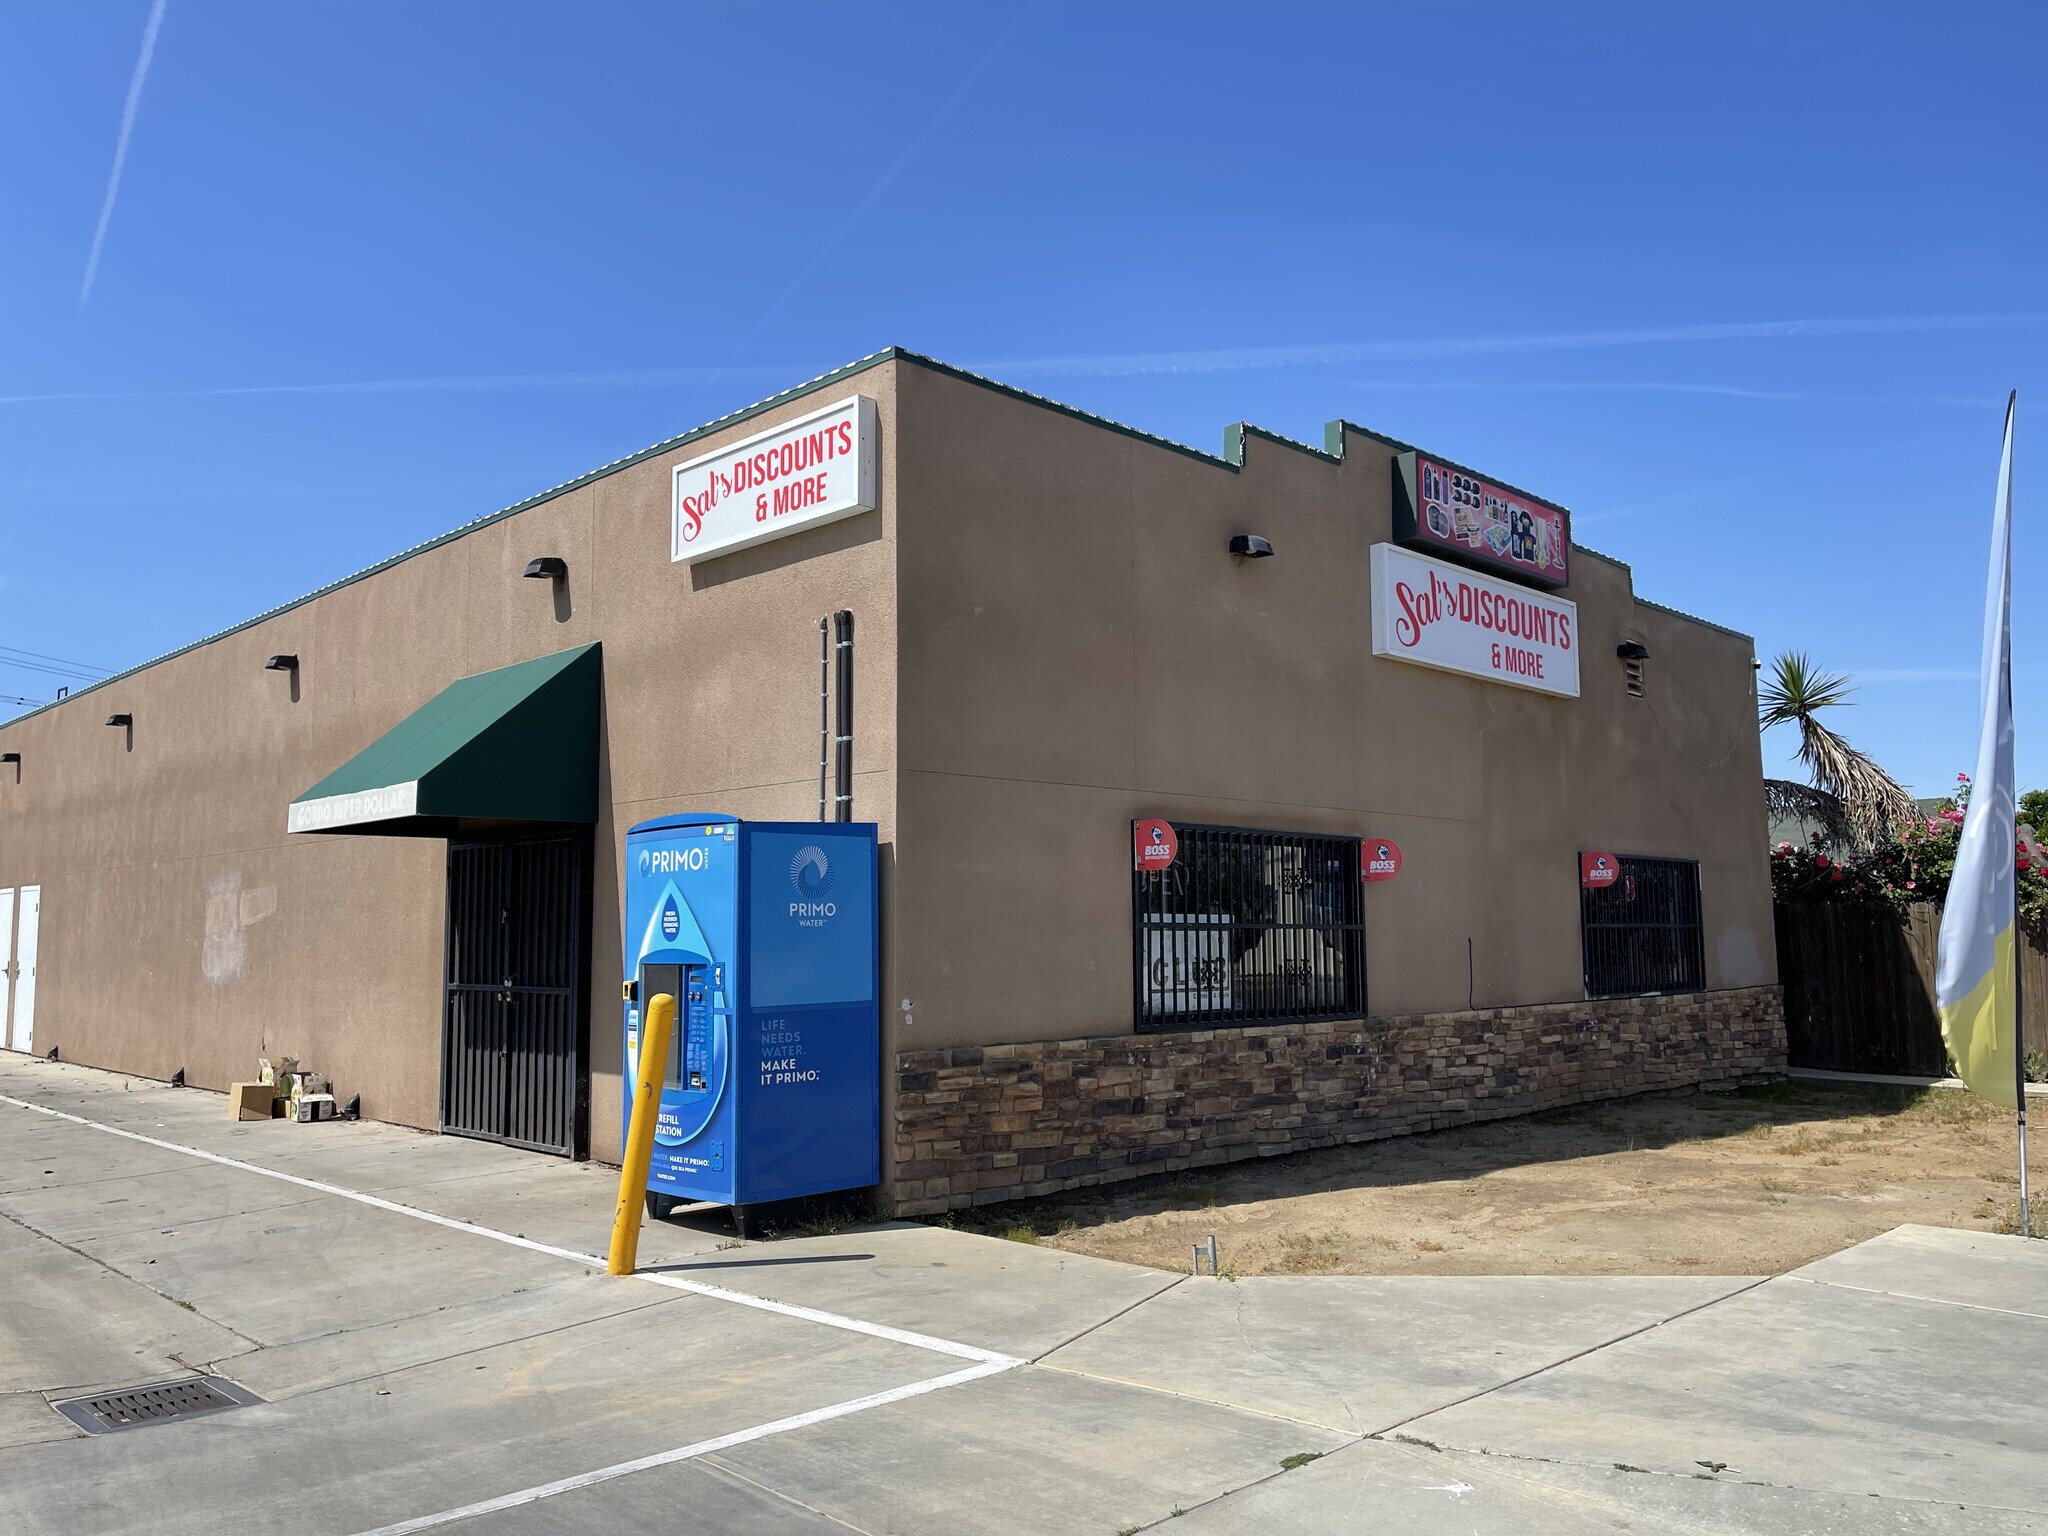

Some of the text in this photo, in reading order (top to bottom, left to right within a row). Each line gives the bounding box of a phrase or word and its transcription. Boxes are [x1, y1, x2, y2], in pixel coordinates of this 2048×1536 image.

[682, 420, 852, 542] Sal's DISCOUNTS
[755, 472, 828, 522] & MORE
[1395, 570, 1571, 650] Sal's DISCOUNTS
[1491, 643, 1544, 680] & MORE
[298, 790, 405, 827] GORDO SUPER DOLLAR
[1145, 844, 1170, 856] BOSS
[652, 847, 703, 874] PRIMO
[1370, 860, 1395, 869] BOSS
[1590, 869, 1612, 877] BOSS
[789, 902, 836, 917] PRIMO
[761, 1019, 786, 1031] LIFE
[761, 1032, 801, 1044] NEEDS
[761, 1045, 806, 1058] WATER.
[761, 1058, 796, 1072] MAKE
[761, 1074, 773, 1086] IT
[658, 1113, 679, 1125] REFILL
[655, 1124, 682, 1137] STATION
[669, 1155, 683, 1164] MAKE
